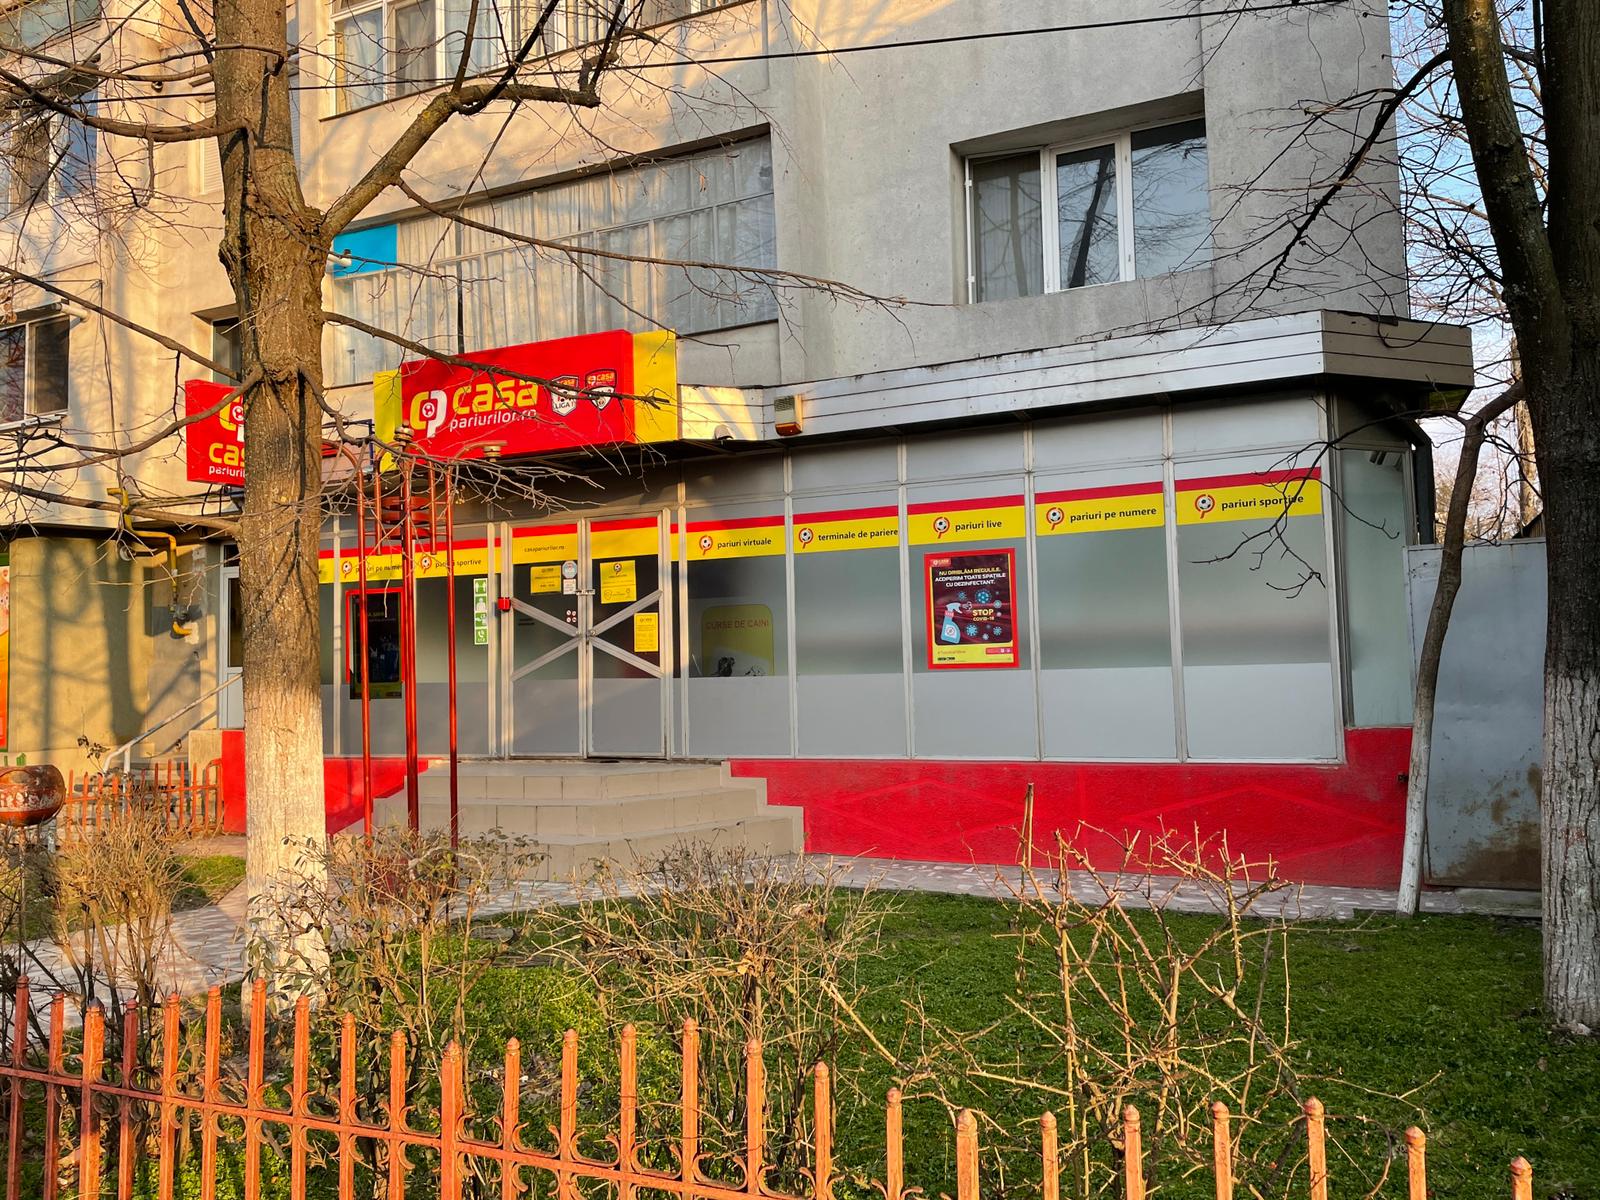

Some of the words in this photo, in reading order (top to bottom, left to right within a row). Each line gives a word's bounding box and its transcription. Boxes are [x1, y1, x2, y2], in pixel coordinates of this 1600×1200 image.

[452, 378, 539, 415] casa
[449, 408, 537, 432] pariurilor.ro
[1221, 498, 1257, 511] pariuri
[1069, 511, 1102, 523] pariuri
[1104, 510, 1117, 521] pe
[1119, 507, 1157, 518] numere
[954, 520, 985, 532] pariuri
[986, 519, 1002, 529] live
[818, 532, 856, 541] terminale
[857, 530, 868, 539] de
[869, 528, 898, 538] pariere
[717, 538, 742, 549] pariuri
[742, 537, 772, 546] virtuale
[456, 558, 482, 567] sportive
[972, 608, 994, 617] STOP
[734, 619, 745, 629] DE
